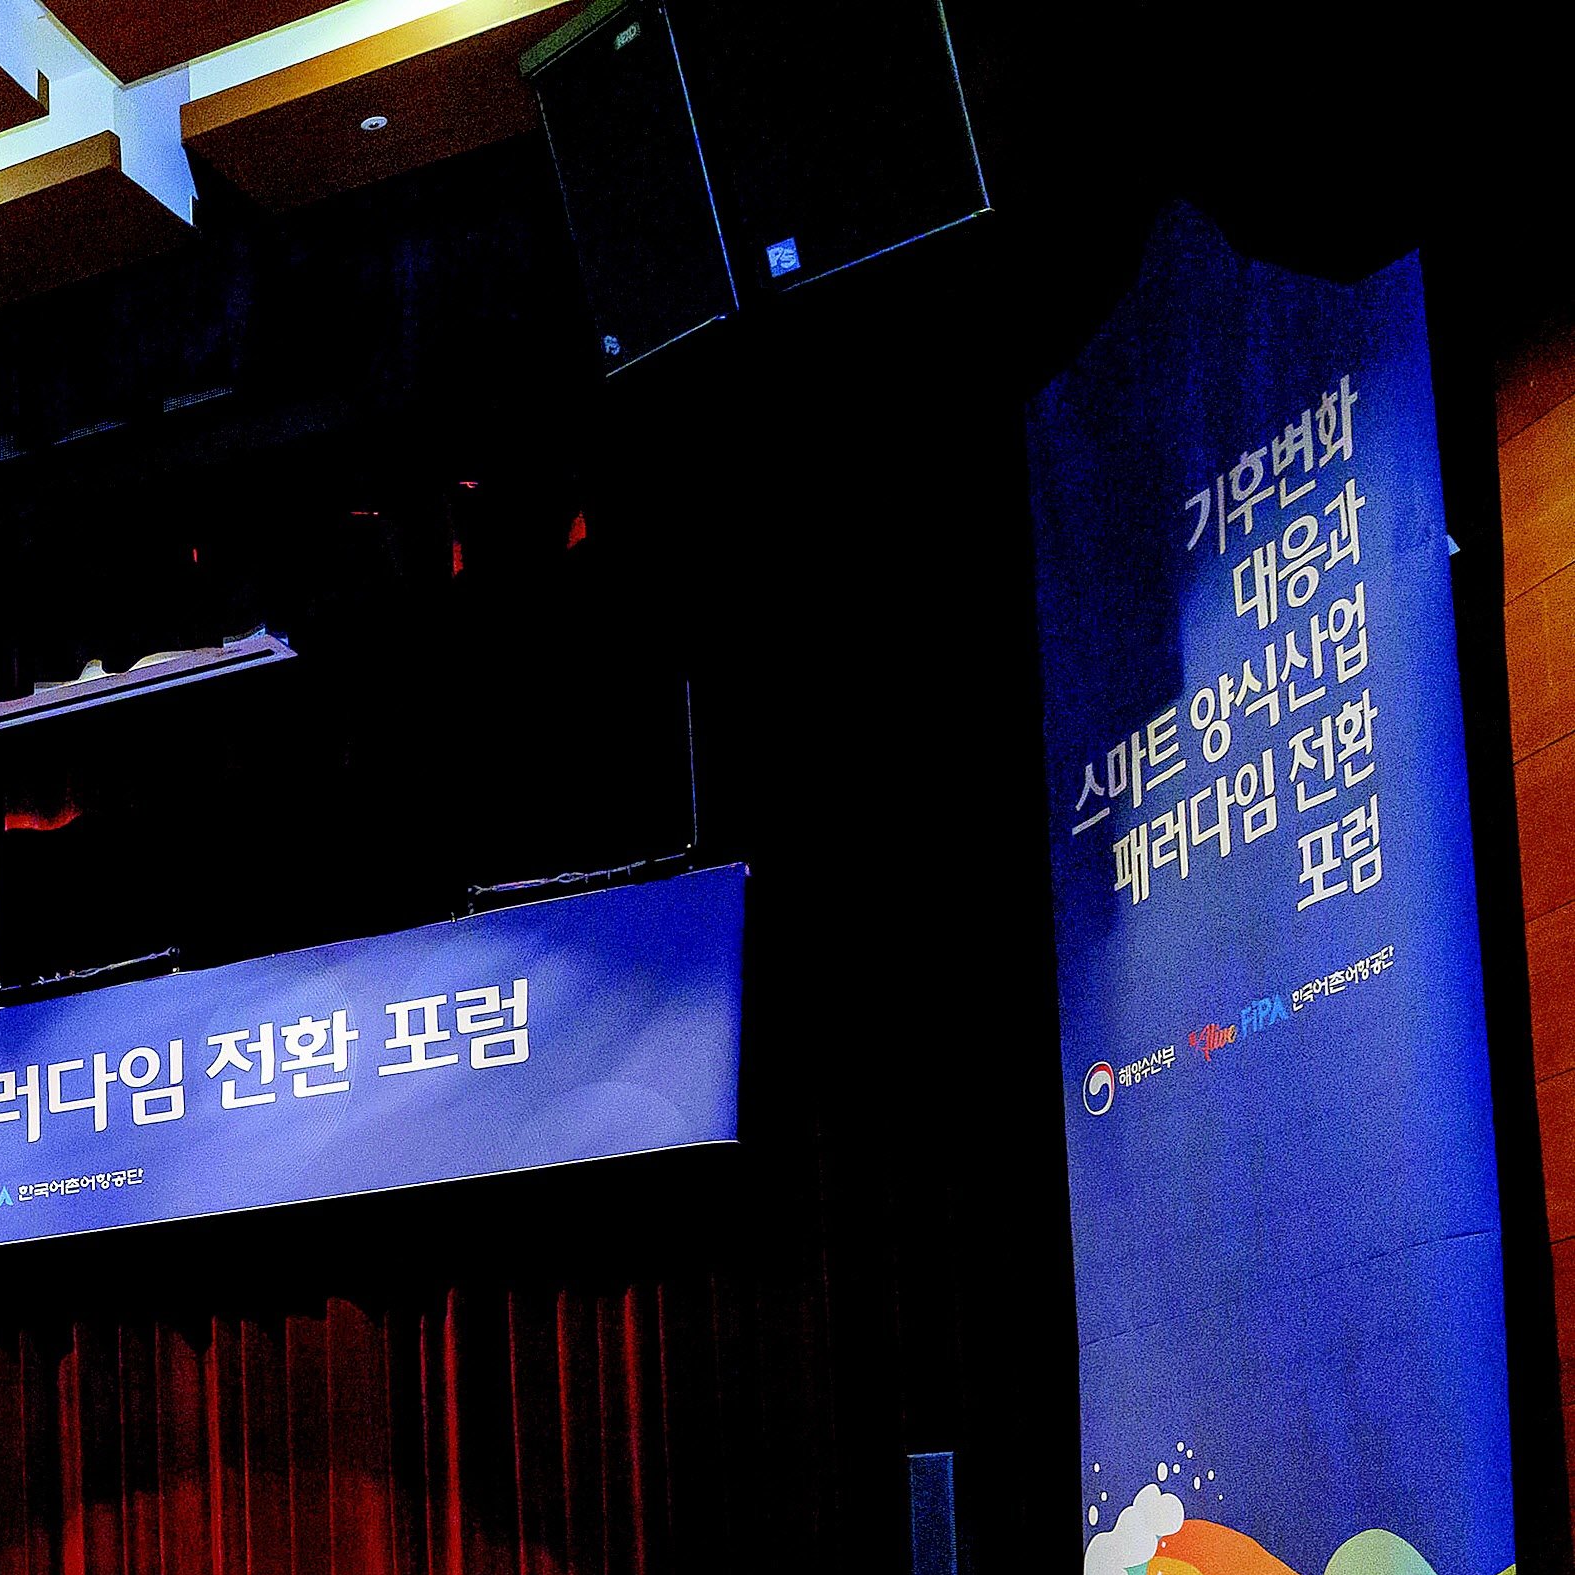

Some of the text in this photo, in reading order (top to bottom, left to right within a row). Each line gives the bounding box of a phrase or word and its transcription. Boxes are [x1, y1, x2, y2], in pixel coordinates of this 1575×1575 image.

[1184, 375, 1358, 554] 기후변화
[1233, 479, 1367, 631] 대응과
[1071, 582, 1369, 837] 스마트 양식산업
[1112, 688, 1378, 906] 패러다임 전환
[1297, 794, 1384, 912] 포럼
[205, 1009, 359, 1111] 전환
[376, 978, 531, 1077] 포럼
[1291, 945, 1395, 1012] 한국어촌어항공단
[1117, 1045, 1176, 1087] 해양수산부
[17, 1168, 144, 1202] 한국어촌어항공단
